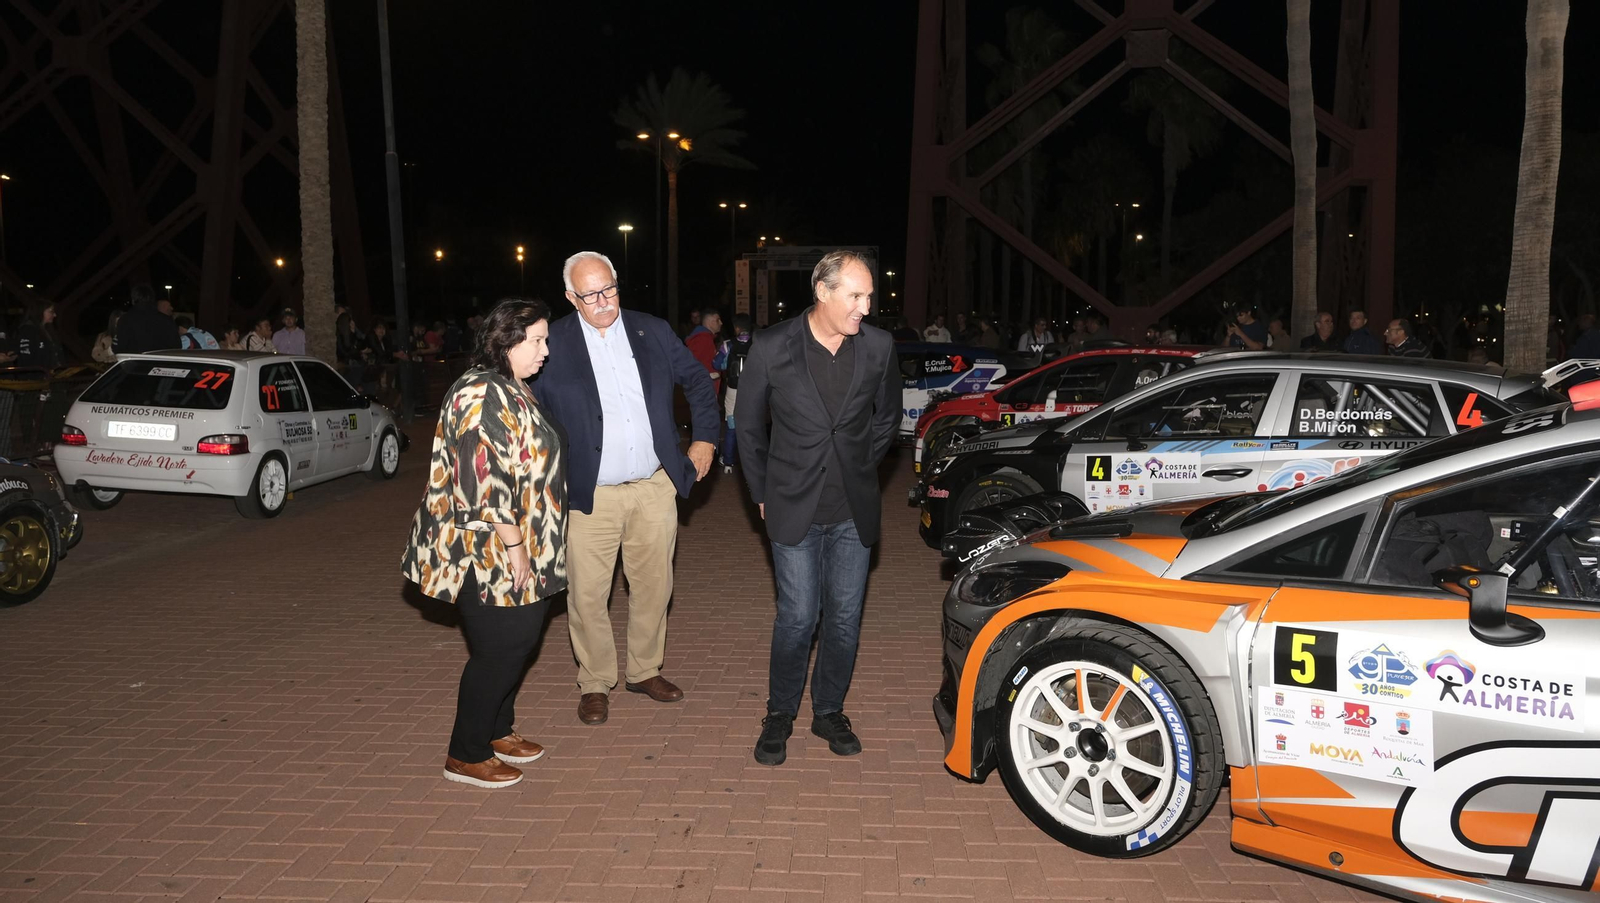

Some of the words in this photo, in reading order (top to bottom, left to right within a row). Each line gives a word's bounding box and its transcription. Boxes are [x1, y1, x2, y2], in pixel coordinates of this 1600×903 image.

[925, 359, 946, 367] E.Cruz
[925, 364, 952, 373] Y.Mujica
[952, 355, 962, 373] 2
[194, 371, 230, 390] 27
[261, 385, 280, 410] 27
[91, 405, 150, 417] NEUMÁTICOS
[151, 408, 194, 420] PREMIER
[1300, 407, 1392, 421] D.Berdomás
[1457, 392, 1483, 429] 4
[350, 415, 357, 429] 27
[1004, 414, 1012, 427] 3
[1299, 419, 1357, 433] B.Mirón
[114, 424, 125, 434] TF
[129, 425, 157, 437] 6399
[158, 427, 173, 438] CC
[956, 441, 1000, 453] HYUNDAI
[85, 449, 125, 465] Lavadero
[127, 452, 153, 467] Ejido
[1091, 457, 1104, 480] 4
[1158, 470, 1197, 479] ALMERÍA
[1290, 633, 1316, 684] 5
[1361, 683, 1378, 695] 30
[1380, 690, 1404, 699] CONTIGO
[1482, 674, 1543, 692] COSTA
[1549, 681, 1573, 697] DE
[1462, 689, 1575, 721] ALMERÍA
[1152, 692, 1190, 776] MICHELIN
[1309, 742, 1364, 763] MOYA
[1371, 746, 1426, 766] Andalucía
[1174, 787, 1185, 808] PILOT
[1159, 808, 1177, 830] SPORT
